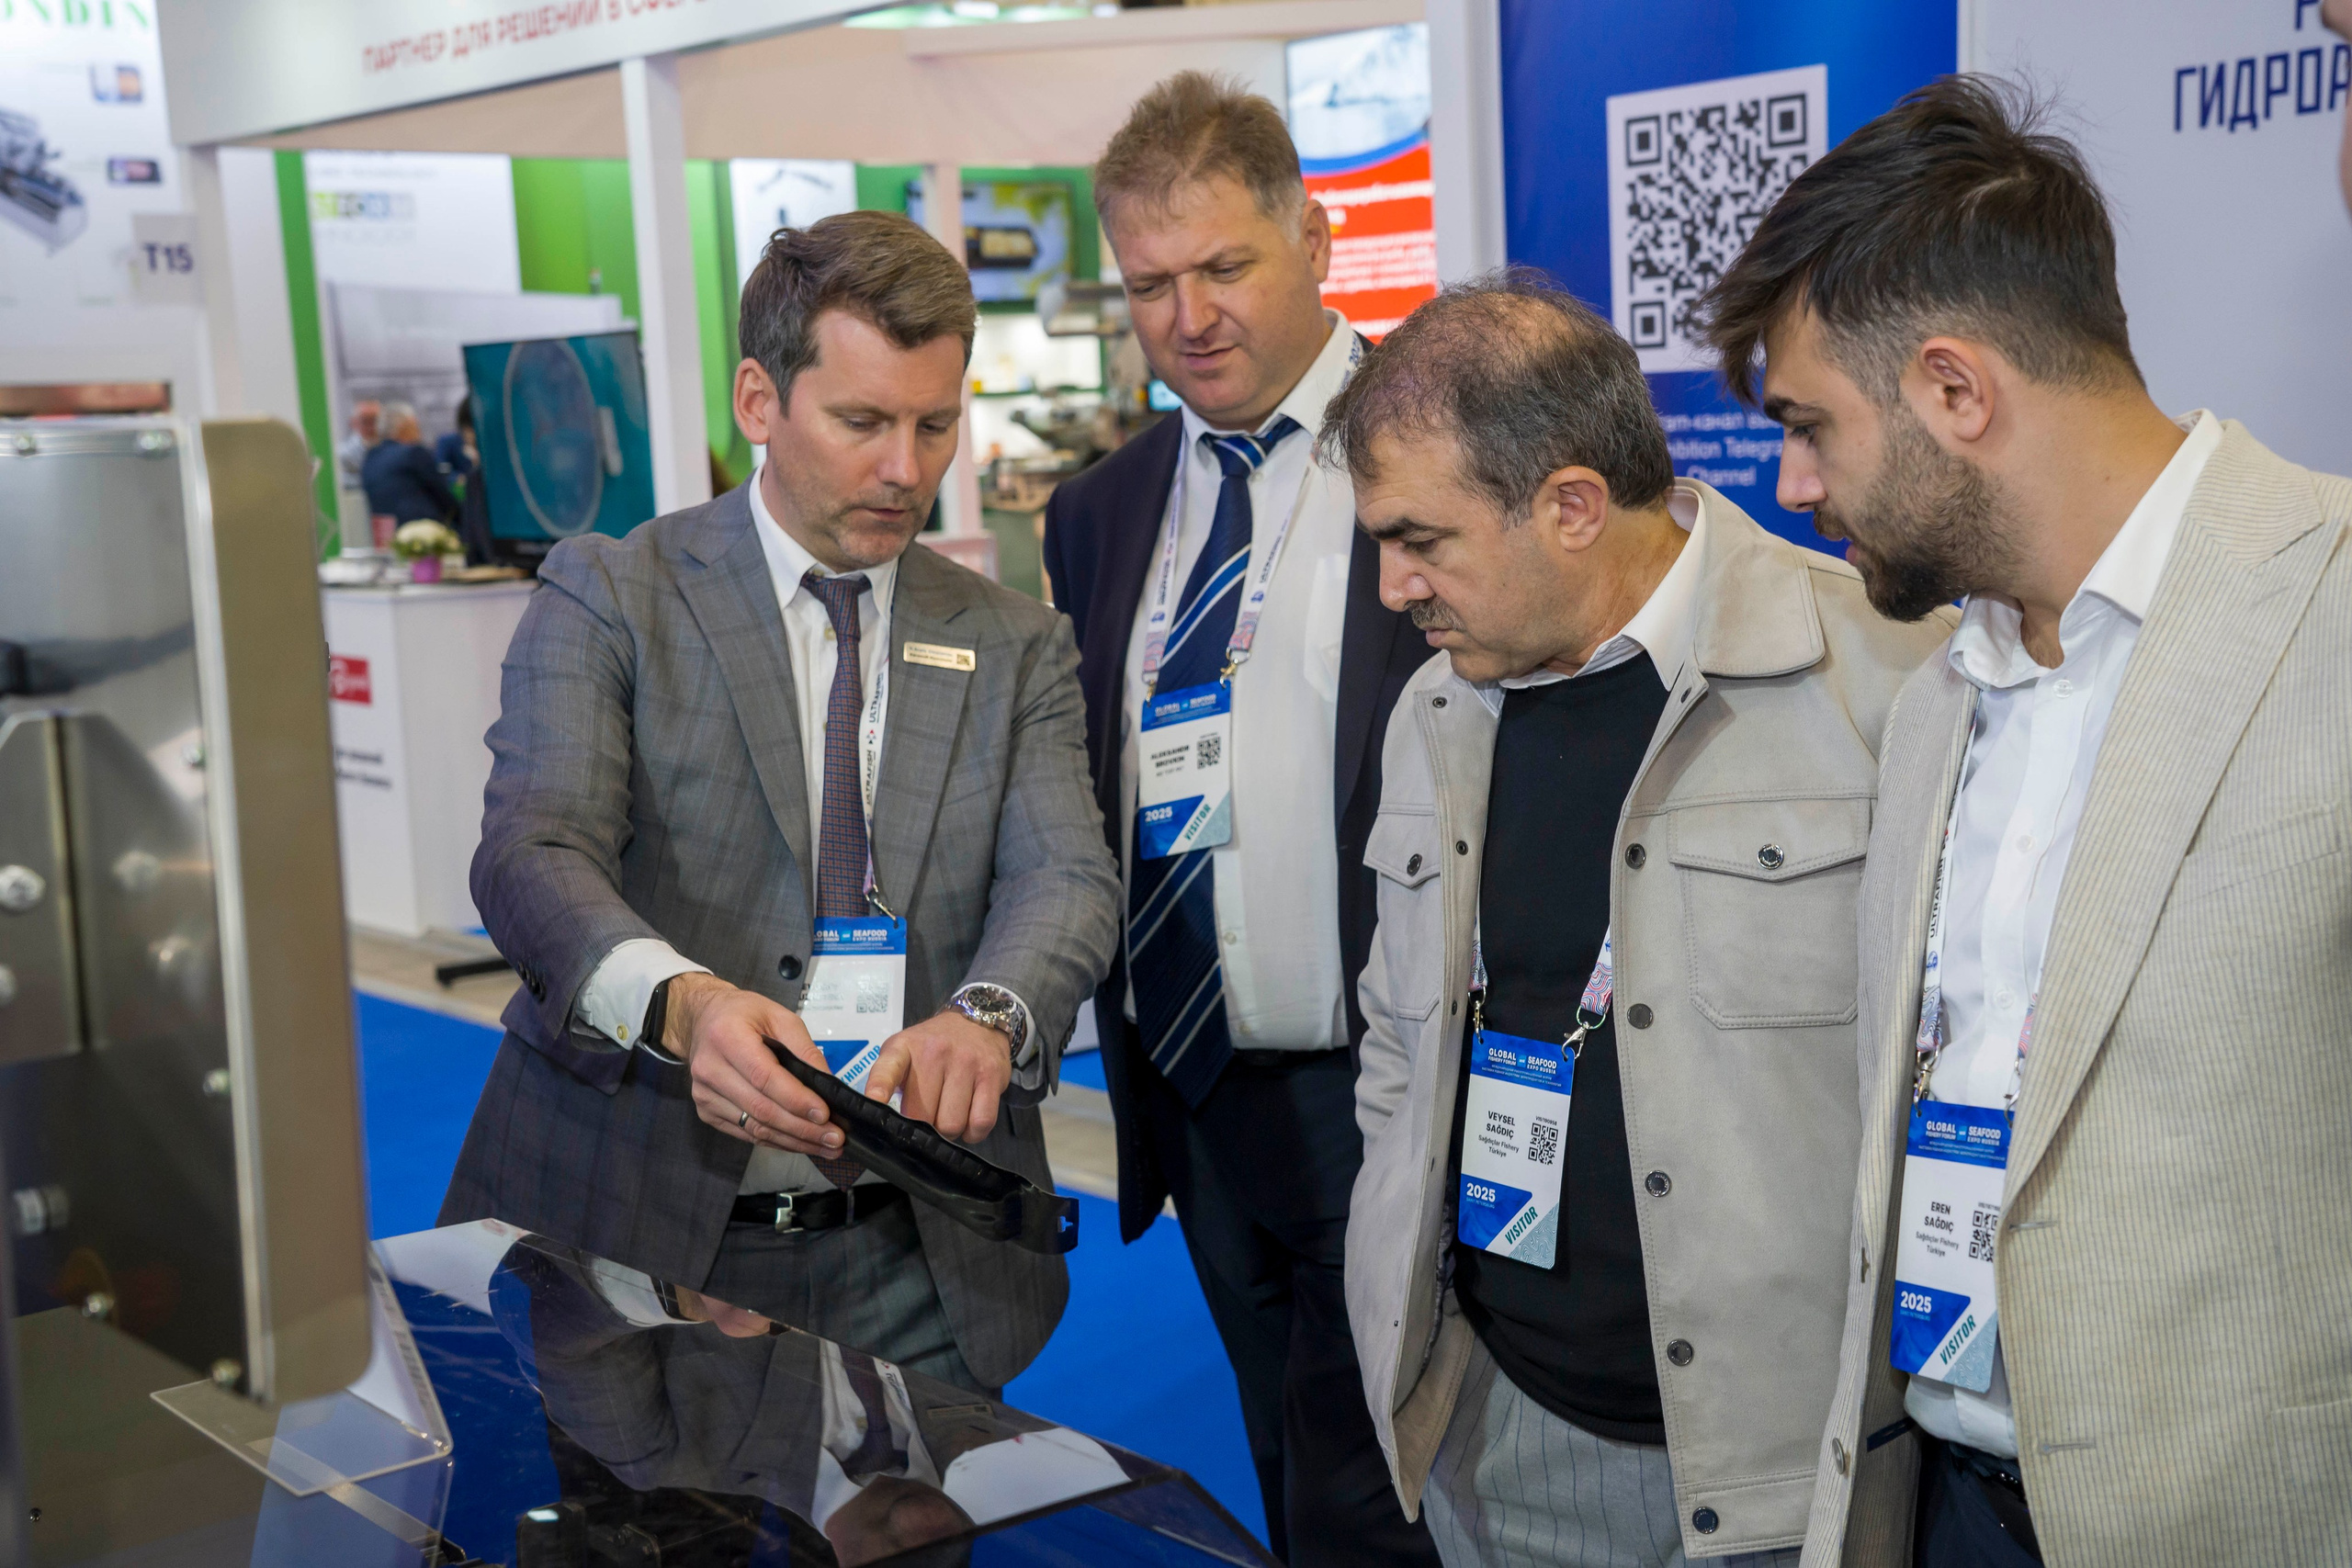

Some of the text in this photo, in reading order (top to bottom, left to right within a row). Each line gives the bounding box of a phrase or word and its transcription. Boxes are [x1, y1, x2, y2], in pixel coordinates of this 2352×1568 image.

[362, 29, 447, 73] ПАРТНЕР
[450, 20, 492, 59] ДЛЯ
[142, 242, 194, 274] T15
[869, 671, 884, 724] ULTRAFISH
[1145, 806, 1173, 823] 2025
[1183, 803, 1212, 841] VISITOR
[1929, 857, 1944, 939] ULTRAFISH
[814, 930, 839, 938] OBAL
[853, 929, 888, 937] SEAFOOD
[1488, 1047, 1517, 1061] GLOBAL
[1527, 1055, 1557, 1069] SEAFOOD
[1503, 1058, 1517, 1066] FORUM
[1540, 1066, 1556, 1075] RUSSIA
[1487, 1111, 1516, 1126] VEYSEL
[1486, 1122, 1514, 1141] SAĞDIÇ
[1926, 1120, 1957, 1134] GLOBAL
[1968, 1125, 2002, 1140] SEAFOOD
[1488, 1146, 1507, 1158] Türkiye
[1500, 1140, 1520, 1154] Fishery
[1466, 1182, 1496, 1202] 2025
[1930, 1201, 1951, 1215] EREN
[1505, 1206, 1539, 1245] VISITOR
[1924, 1215, 1954, 1235] SAĞDIÇ
[1927, 1245, 1946, 1258] Türkiye
[1900, 1291, 1932, 1314] 2025
[1939, 1314, 1976, 1366] VISITOR
